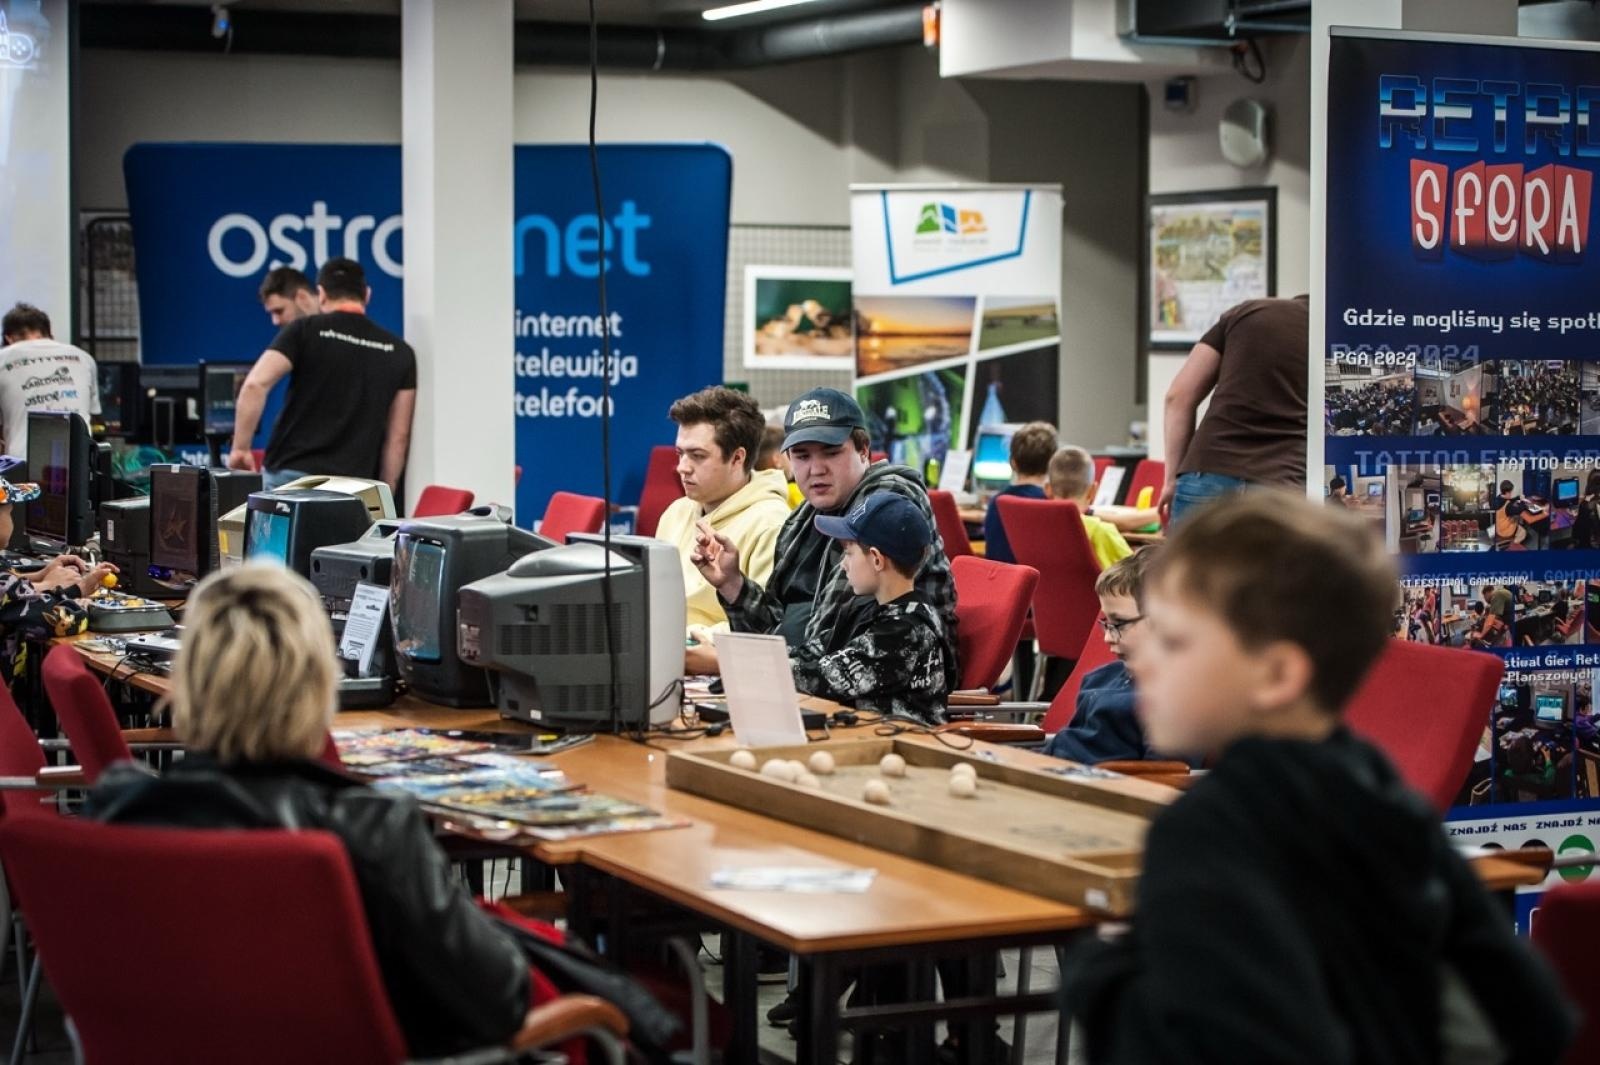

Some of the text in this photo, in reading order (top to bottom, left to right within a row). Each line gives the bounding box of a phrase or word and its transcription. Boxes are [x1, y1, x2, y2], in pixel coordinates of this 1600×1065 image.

[515, 310, 623, 338] internet
[1343, 308, 1406, 327] Gdzie
[1412, 311, 1504, 333] mogliśmy
[1510, 312, 1541, 331] się
[515, 347, 638, 386] telewizja
[1333, 351, 1417, 369] PGA 2024
[515, 387, 615, 418] telefon
[1499, 457, 1558, 470] TATTOO
[1544, 654, 1572, 667] Gier
[1450, 823, 1498, 836] ZNAJDŹ
[1503, 823, 1527, 832] NAS
[1536, 816, 1583, 829] ZNAJDŹ
